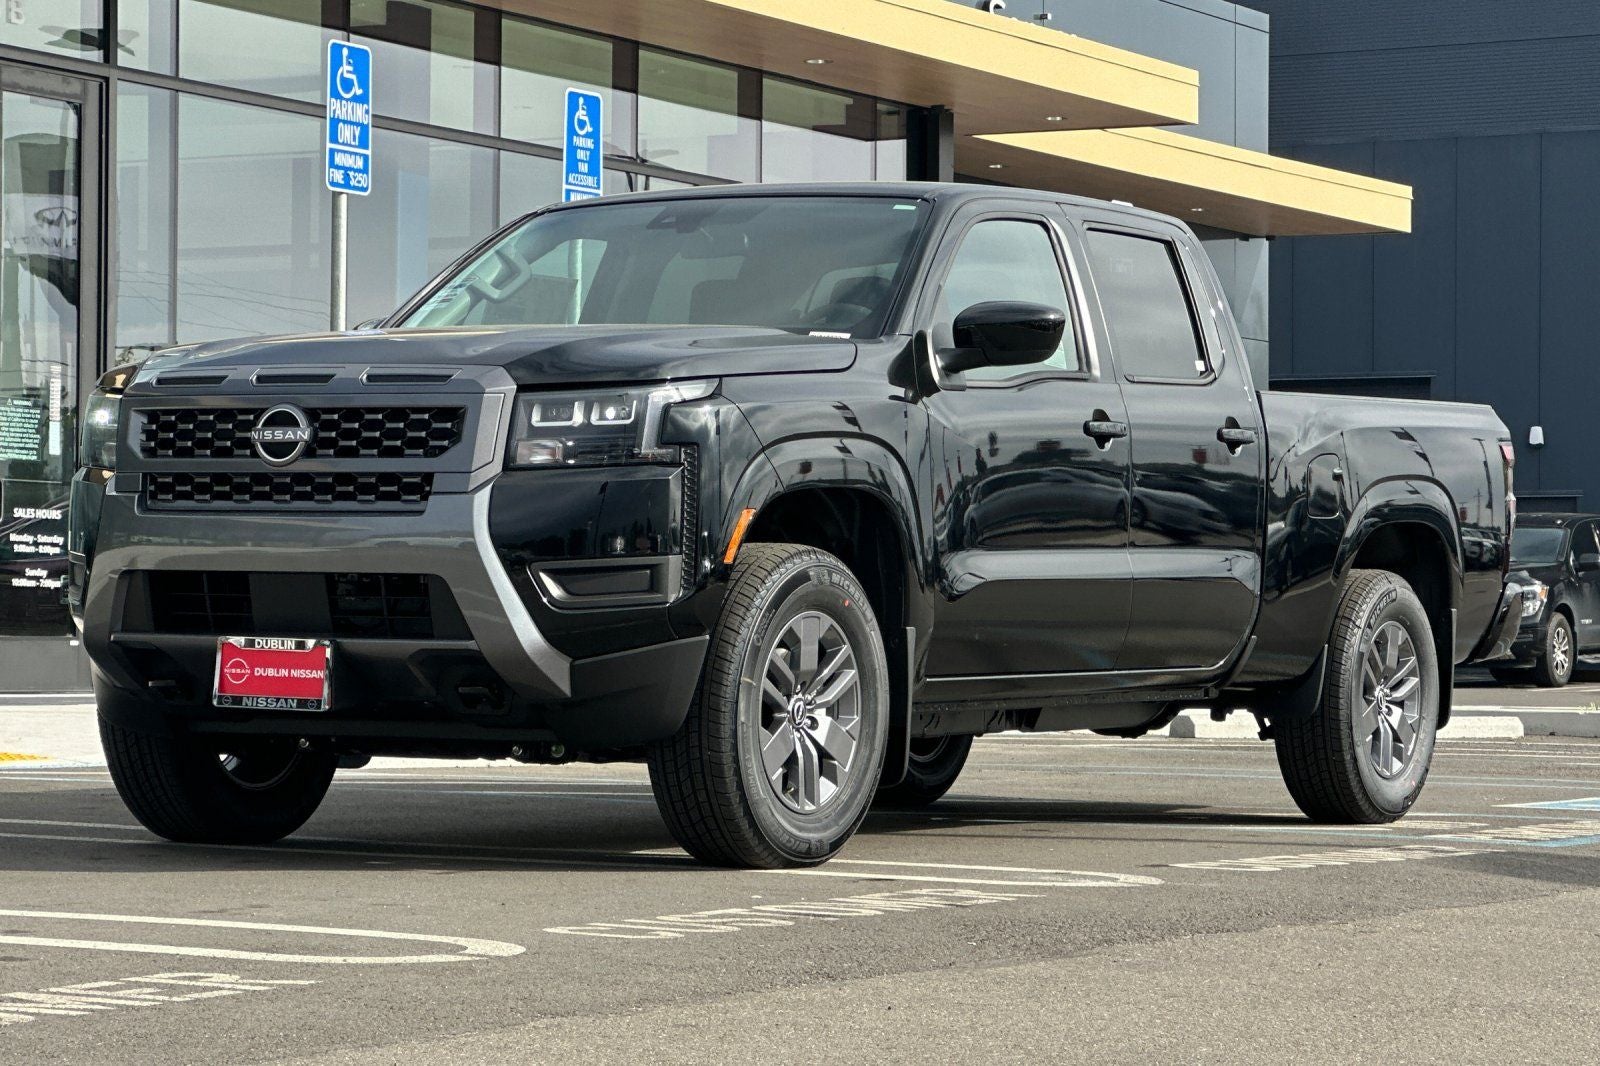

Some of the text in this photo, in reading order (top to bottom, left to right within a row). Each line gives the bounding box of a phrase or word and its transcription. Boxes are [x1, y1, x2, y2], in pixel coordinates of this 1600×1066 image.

[330, 97, 369, 125] PARKING
[337, 122, 361, 146] ONLY
[572, 135, 595, 150] PARKING
[334, 151, 364, 170] MINIMUM
[576, 149, 591, 161] ONLY
[577, 161, 589, 173] VAN
[329, 168, 368, 188] FINE $250
[568, 172, 598, 188] ACCESSIBLE
[251, 430, 309, 440] NISSAN
[13, 507, 62, 520] SALES HOURS
[10, 533, 34, 544] Monday
[37, 534, 64, 546] Saturday
[25, 567, 48, 579] Sunday
[255, 639, 295, 650] DUBLIN
[254, 667, 324, 679] DUBLIN NISSAN
[242, 696, 297, 709] NISSAN
[542, 888, 1047, 939] CUSTOMER
